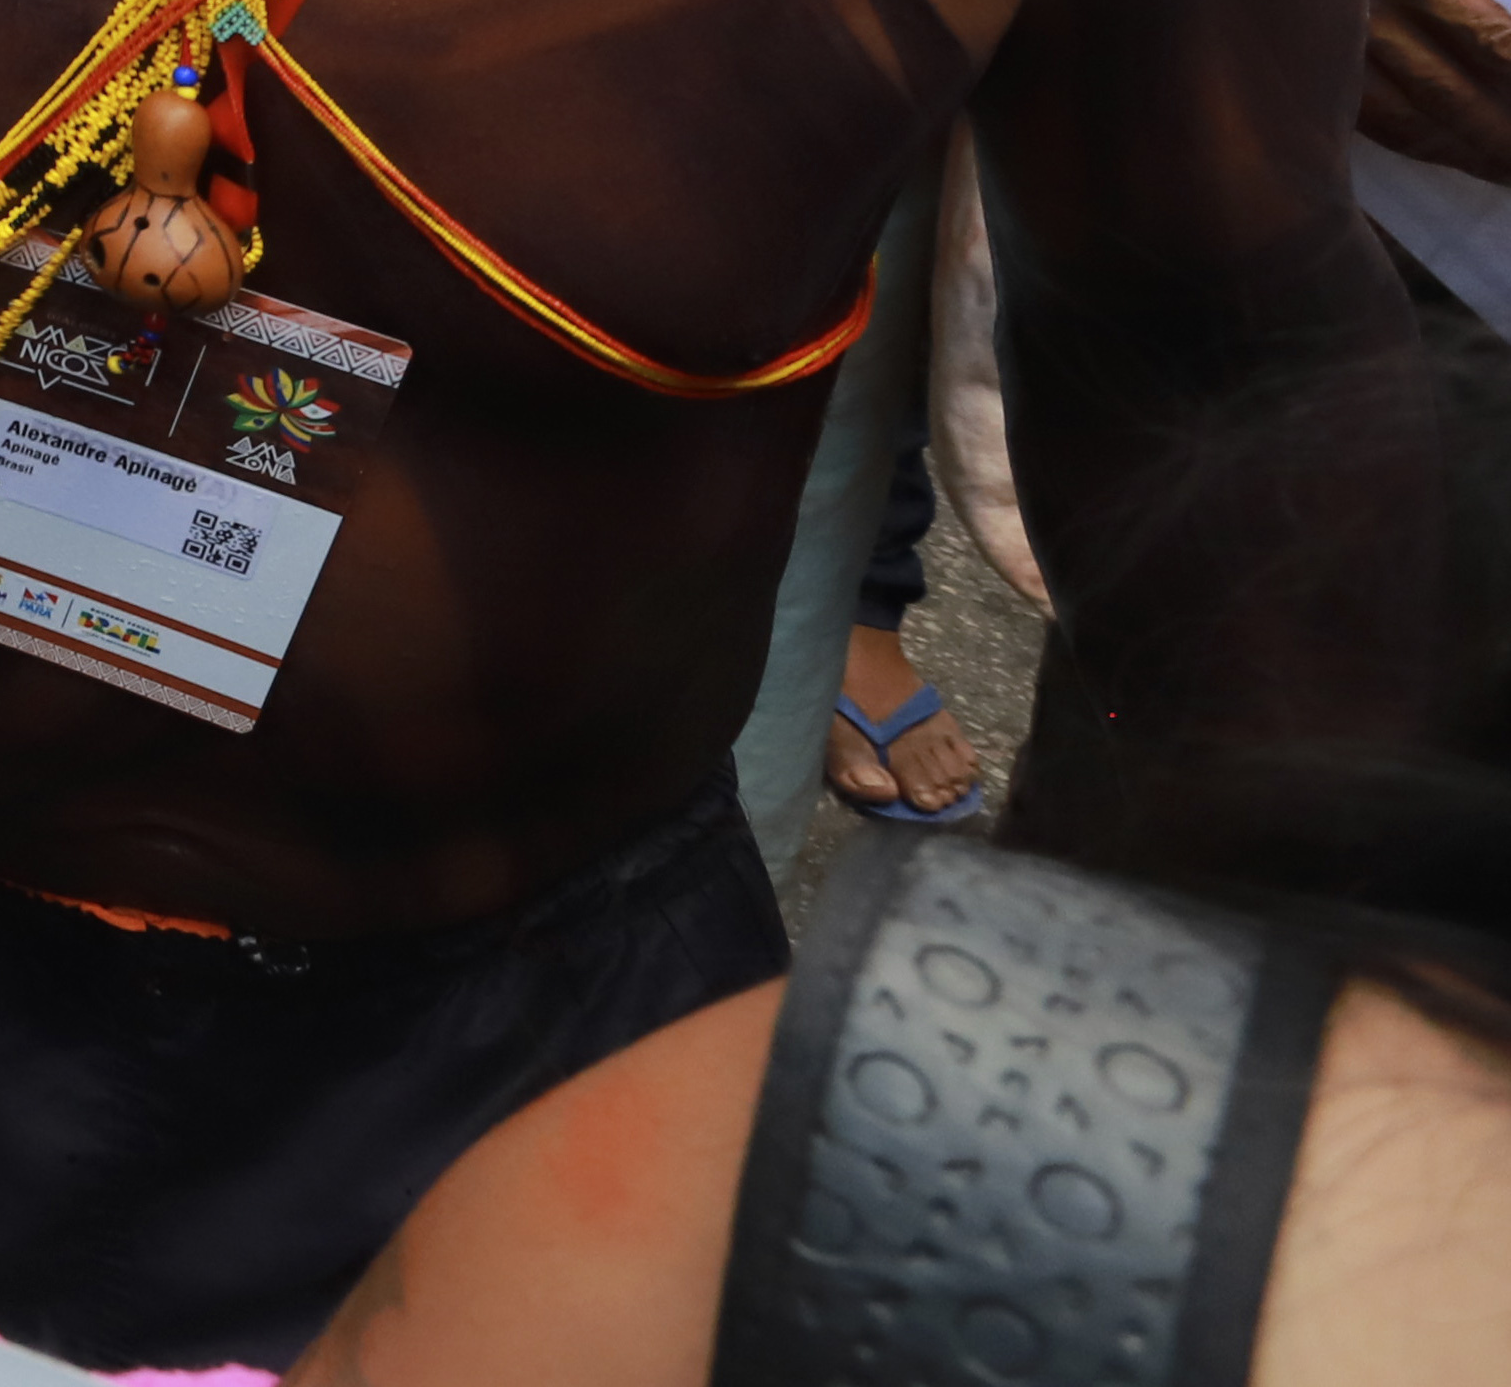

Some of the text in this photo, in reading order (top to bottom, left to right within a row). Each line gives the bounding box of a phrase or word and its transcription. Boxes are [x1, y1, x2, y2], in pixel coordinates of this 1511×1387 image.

[0, 437, 61, 467] Apinagé
[7, 419, 198, 494] Alexandre Apinagé
